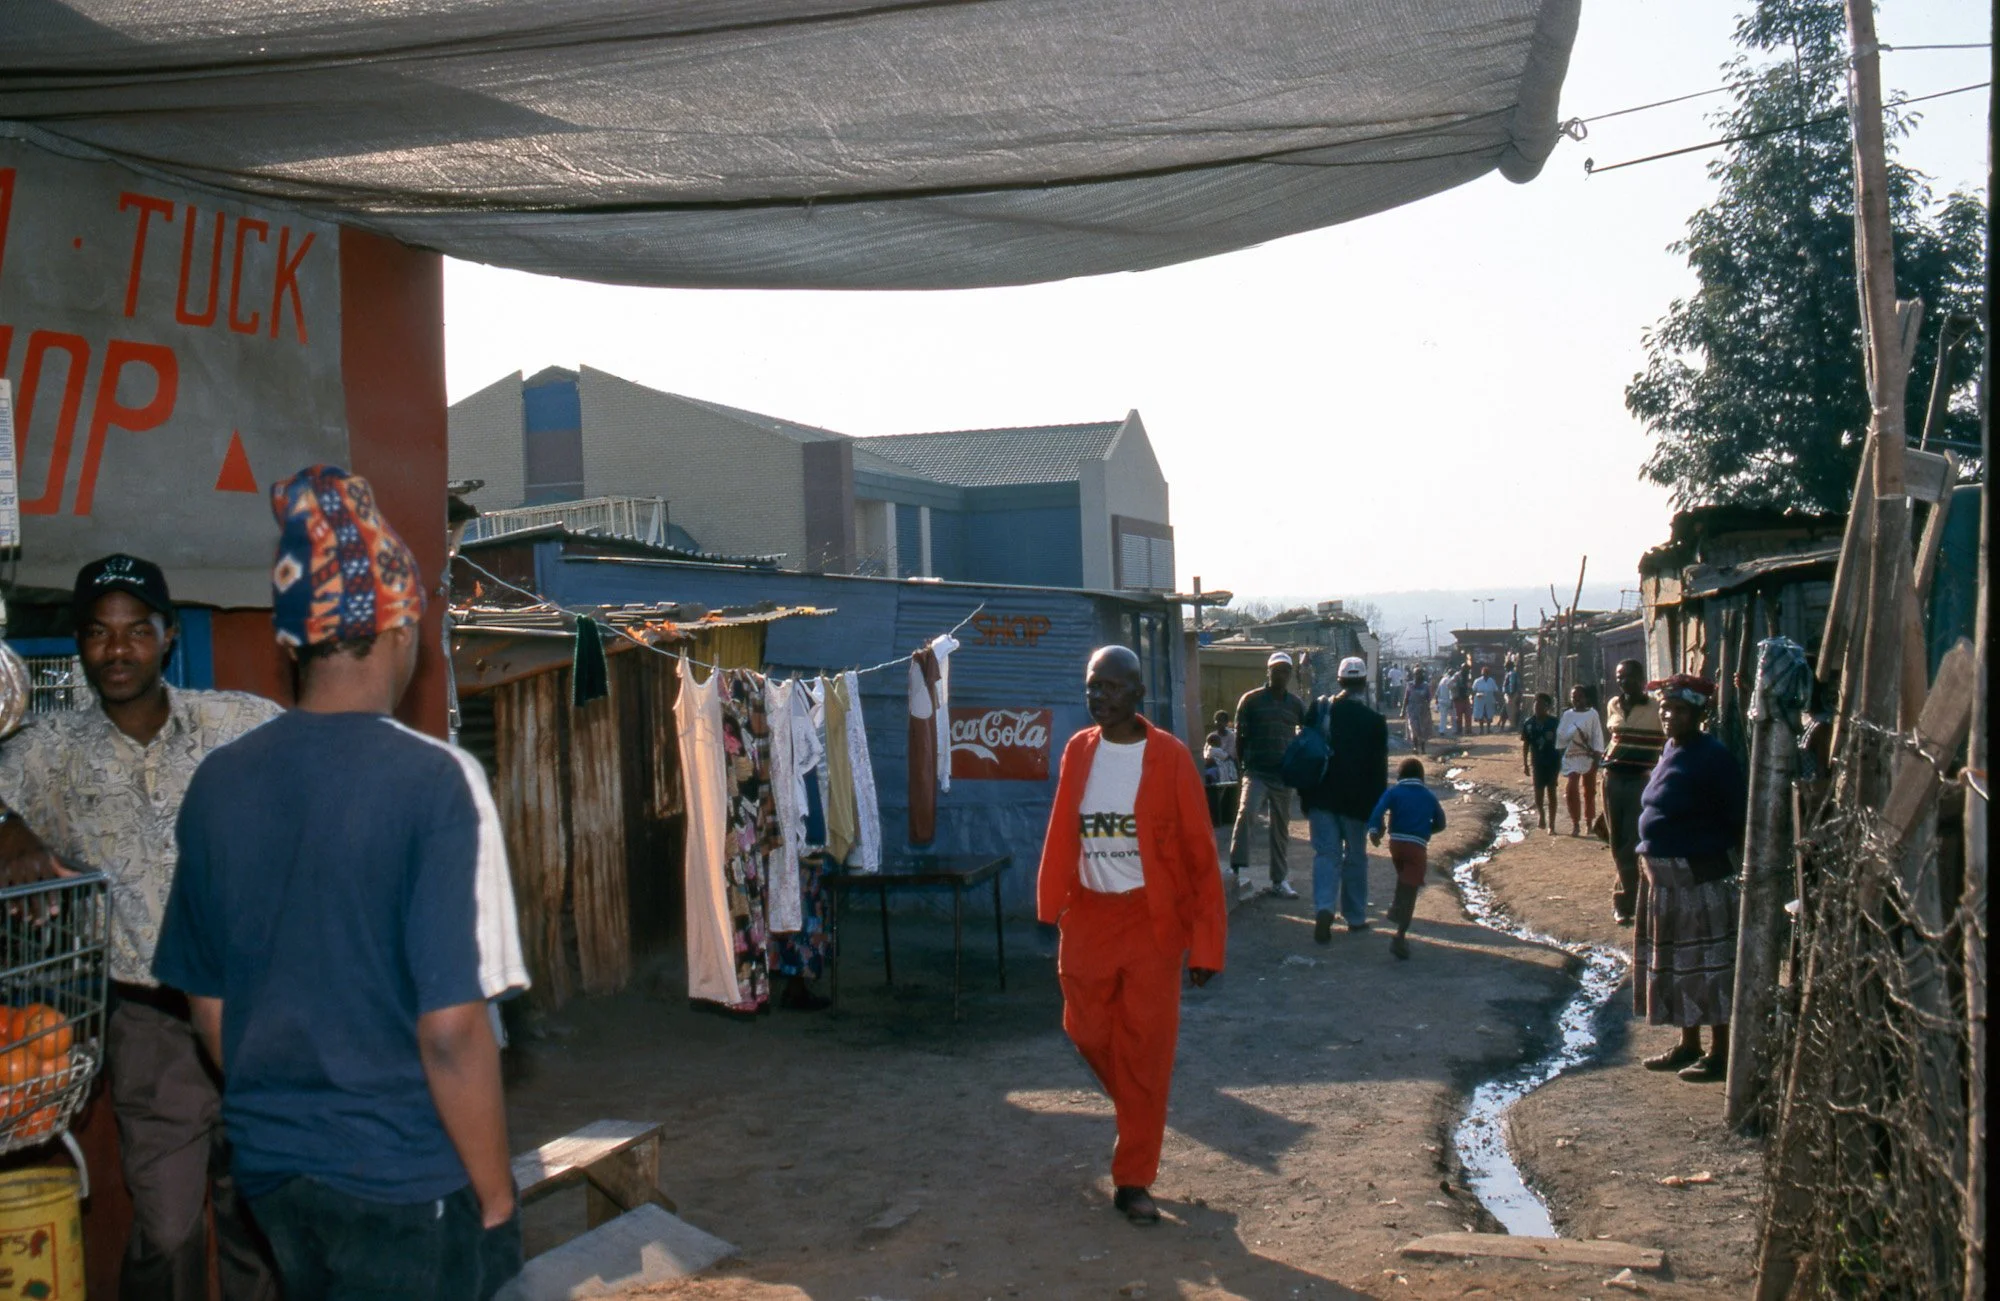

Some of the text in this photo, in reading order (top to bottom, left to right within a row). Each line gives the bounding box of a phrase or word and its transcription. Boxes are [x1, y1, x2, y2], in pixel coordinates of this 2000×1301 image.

[118, 191, 316, 345] TUCK
[0, 324, 179, 516] OP
[971, 614, 1051, 646] SHOP
